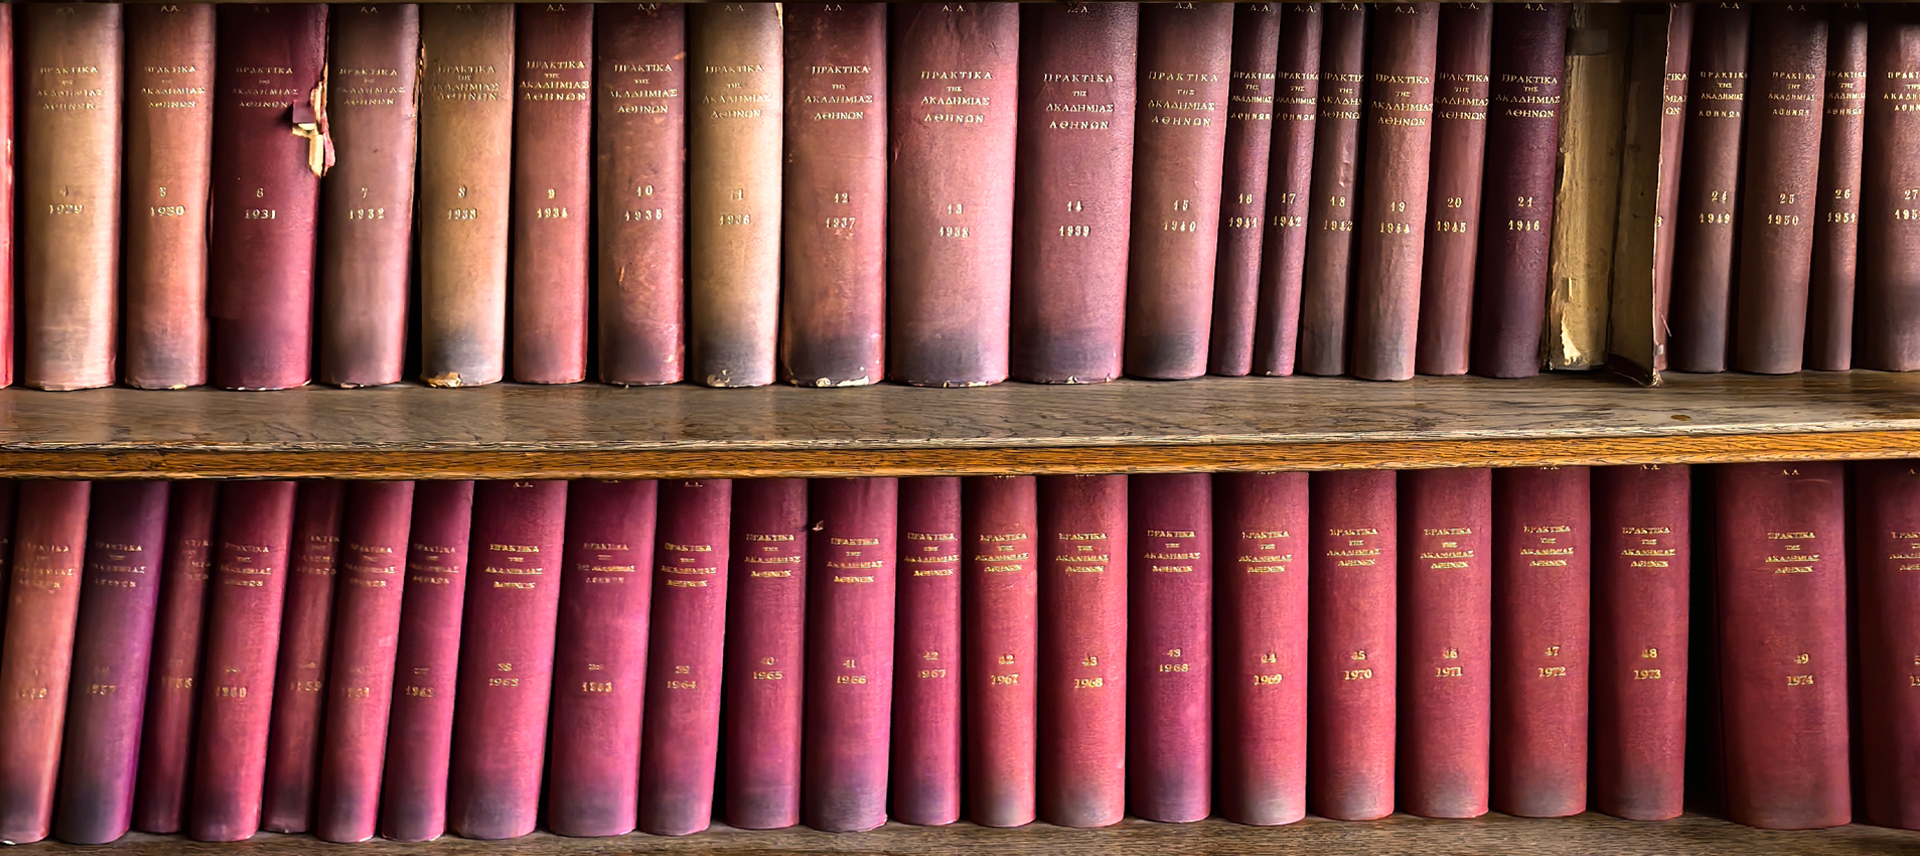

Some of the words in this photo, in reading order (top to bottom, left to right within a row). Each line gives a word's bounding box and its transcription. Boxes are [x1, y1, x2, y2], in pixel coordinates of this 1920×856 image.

[812, 66, 869, 74] ΠΡΑΚΤΙΚΑ
[921, 71, 993, 80] ΠΡΑΚΤΙΚΑ
[1044, 73, 1114, 83] ΠΡΑΚΤΙΚΑ
[1149, 71, 1218, 82] ΠΡΑΚΤΙΚΑ
[1376, 74, 1429, 84] ΠΡΑΚΤΙΚΑ
[1502, 75, 1558, 84] ΠΡΑΚΤΙΚΑ
[922, 97, 990, 106] ΑΚΑΔΗΜΙΑΣ
[1046, 103, 1114, 113] ΑΚΑΔΗΜΙΑΣ
[815, 112, 864, 120] ΑΘΗΝΩΝ
[924, 114, 984, 123] ΑΘΗΝΩΝ
[1505, 109, 1554, 118] ΑΘΗΝΩΝ
[1050, 121, 1109, 130] ΑΘΗΝΩΝ
[1152, 116, 1211, 126] ΑΘΗΝΩΝ
[1378, 117, 1426, 126] ΑΘΗΝΩΝ
[361, 187, 368, 198] 7
[458, 186, 466, 197] 8
[548, 188, 555, 199] 9
[637, 186, 653, 196] 10
[1835, 189, 1850, 199] 26
[1905, 190, 1918, 199] 27
[834, 193, 848, 203] 12
[1239, 194, 1252, 203] 16
[1282, 193, 1296, 203] 17
[1330, 196, 1345, 207] 18
[1448, 197, 1462, 207] 20
[1518, 197, 1533, 207] 21
[1712, 191, 1728, 203] 24
[1780, 194, 1795, 203] 25
[948, 204, 962, 214] 13
[1066, 201, 1083, 212] 14
[1173, 200, 1188, 211] 15
[1391, 202, 1405, 212] 19
[245, 210, 277, 219] 1931
[625, 209, 663, 221] 1935
[1700, 213, 1730, 223] 1949
[1828, 213, 1855, 223] 1951
[1895, 209, 1920, 219] 195
[720, 215, 751, 225] 1936
[826, 218, 856, 228] 1937
[1768, 215, 1799, 225] 1950
[1164, 221, 1196, 232] 1940
[1509, 220, 1540, 231] 1946
[939, 227, 970, 237] 1938
[1059, 226, 1090, 237] 1939
[1167, 649, 1181, 657] 43
[1442, 650, 1457, 658] 46
[1545, 646, 1559, 656] 47
[1642, 648, 1657, 658] 48
[999, 655, 1014, 665] 42
[1082, 657, 1097, 666] 43
[1261, 654, 1276, 663] 44
[1794, 654, 1808, 664] 49
[843, 660, 855, 668] 41
[1159, 663, 1189, 672] 1968
[753, 672, 783, 680] 1965
[1344, 669, 1372, 680] 1970
[1436, 667, 1463, 677] 1971
[1538, 667, 1566, 677] 1972
[1634, 669, 1661, 679] 1973
[837, 676, 867, 684] 1966
[991, 675, 1019, 685] 1967
[1074, 678, 1103, 688] 1968
[1254, 674, 1282, 685] 1969
[1787, 675, 1813, 685] 1974
[667, 681, 696, 689] 1964
